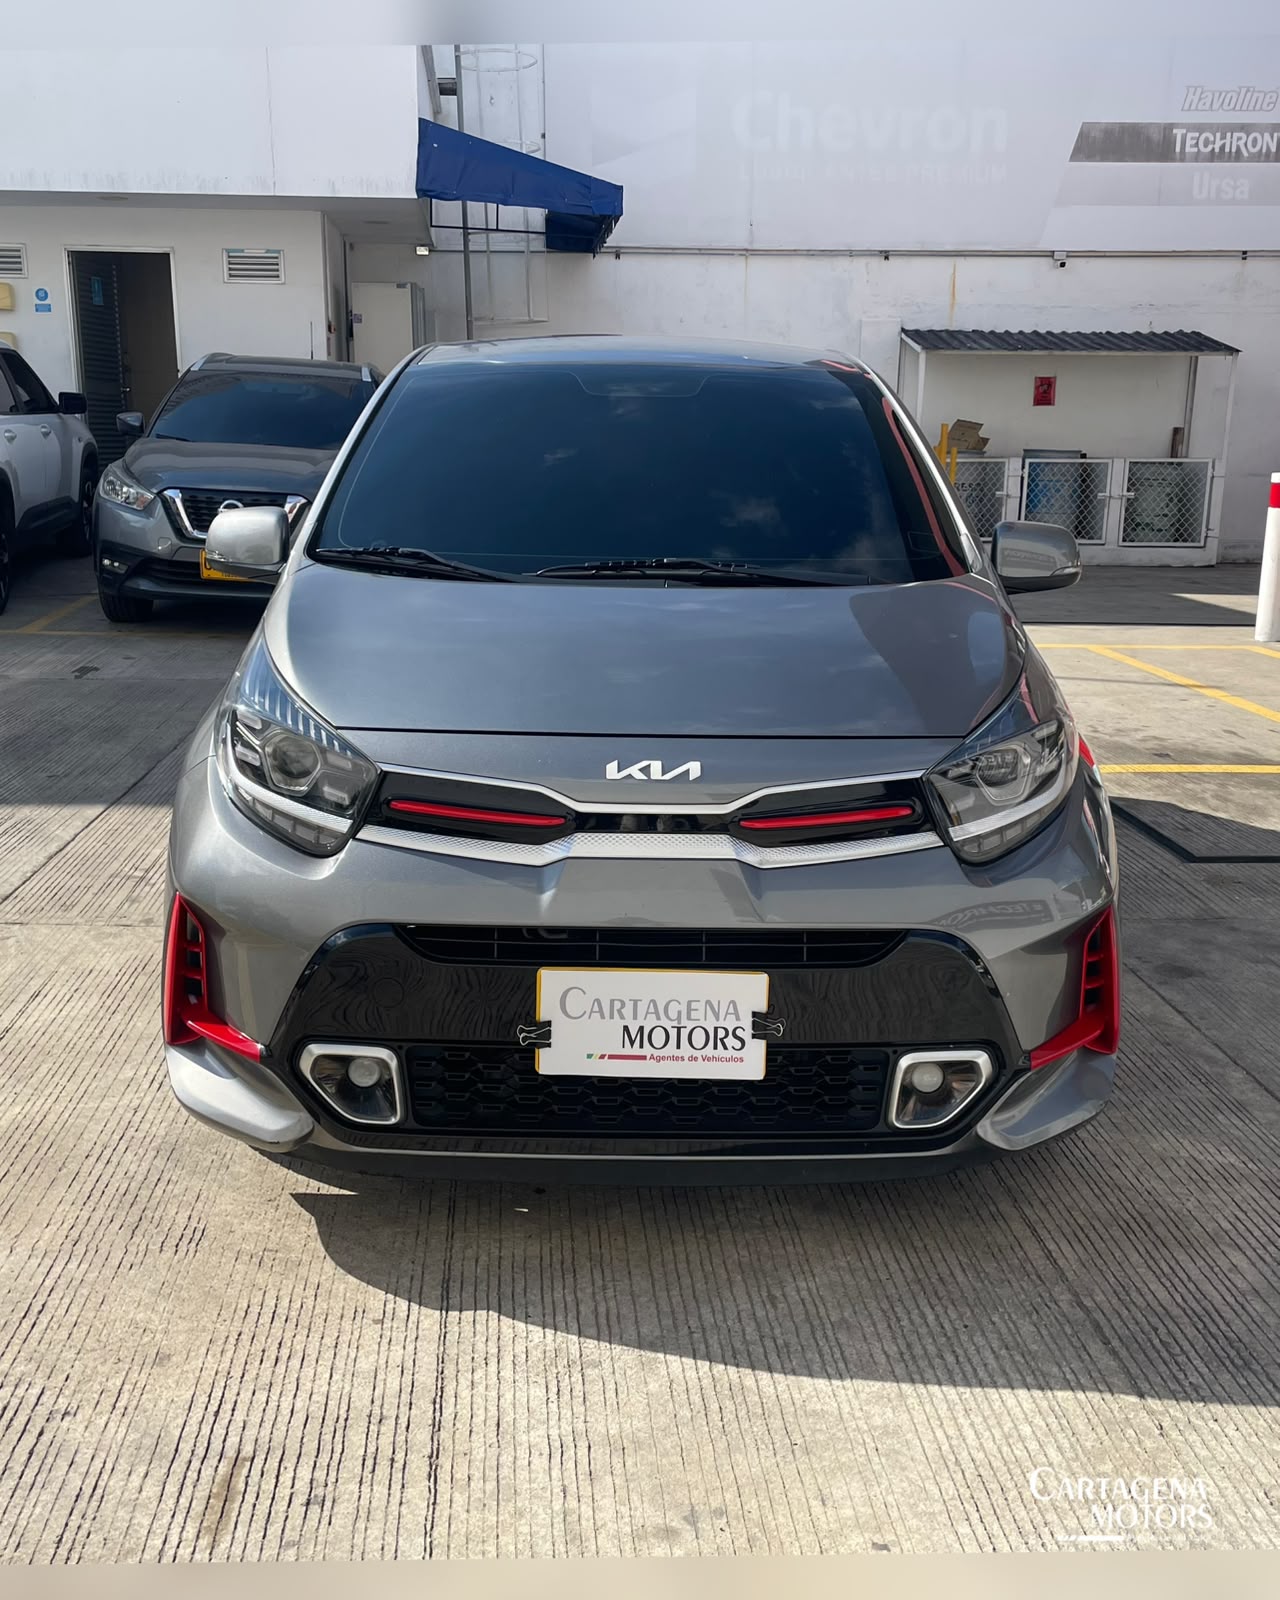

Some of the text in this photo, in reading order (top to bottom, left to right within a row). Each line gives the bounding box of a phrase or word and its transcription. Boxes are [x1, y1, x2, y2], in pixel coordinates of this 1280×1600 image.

[1181, 86, 1279, 112] Havoline
[731, 90, 1008, 152] Chevron
[1172, 128, 1277, 156] TECHRON
[1192, 171, 1249, 200] Ursa
[606, 759, 702, 781] KIA
[559, 986, 742, 1024] CARTAGENA
[622, 1025, 746, 1051] MOTORS
[648, 1053, 685, 1063] Agentes
[687, 1054, 699, 1062] de
